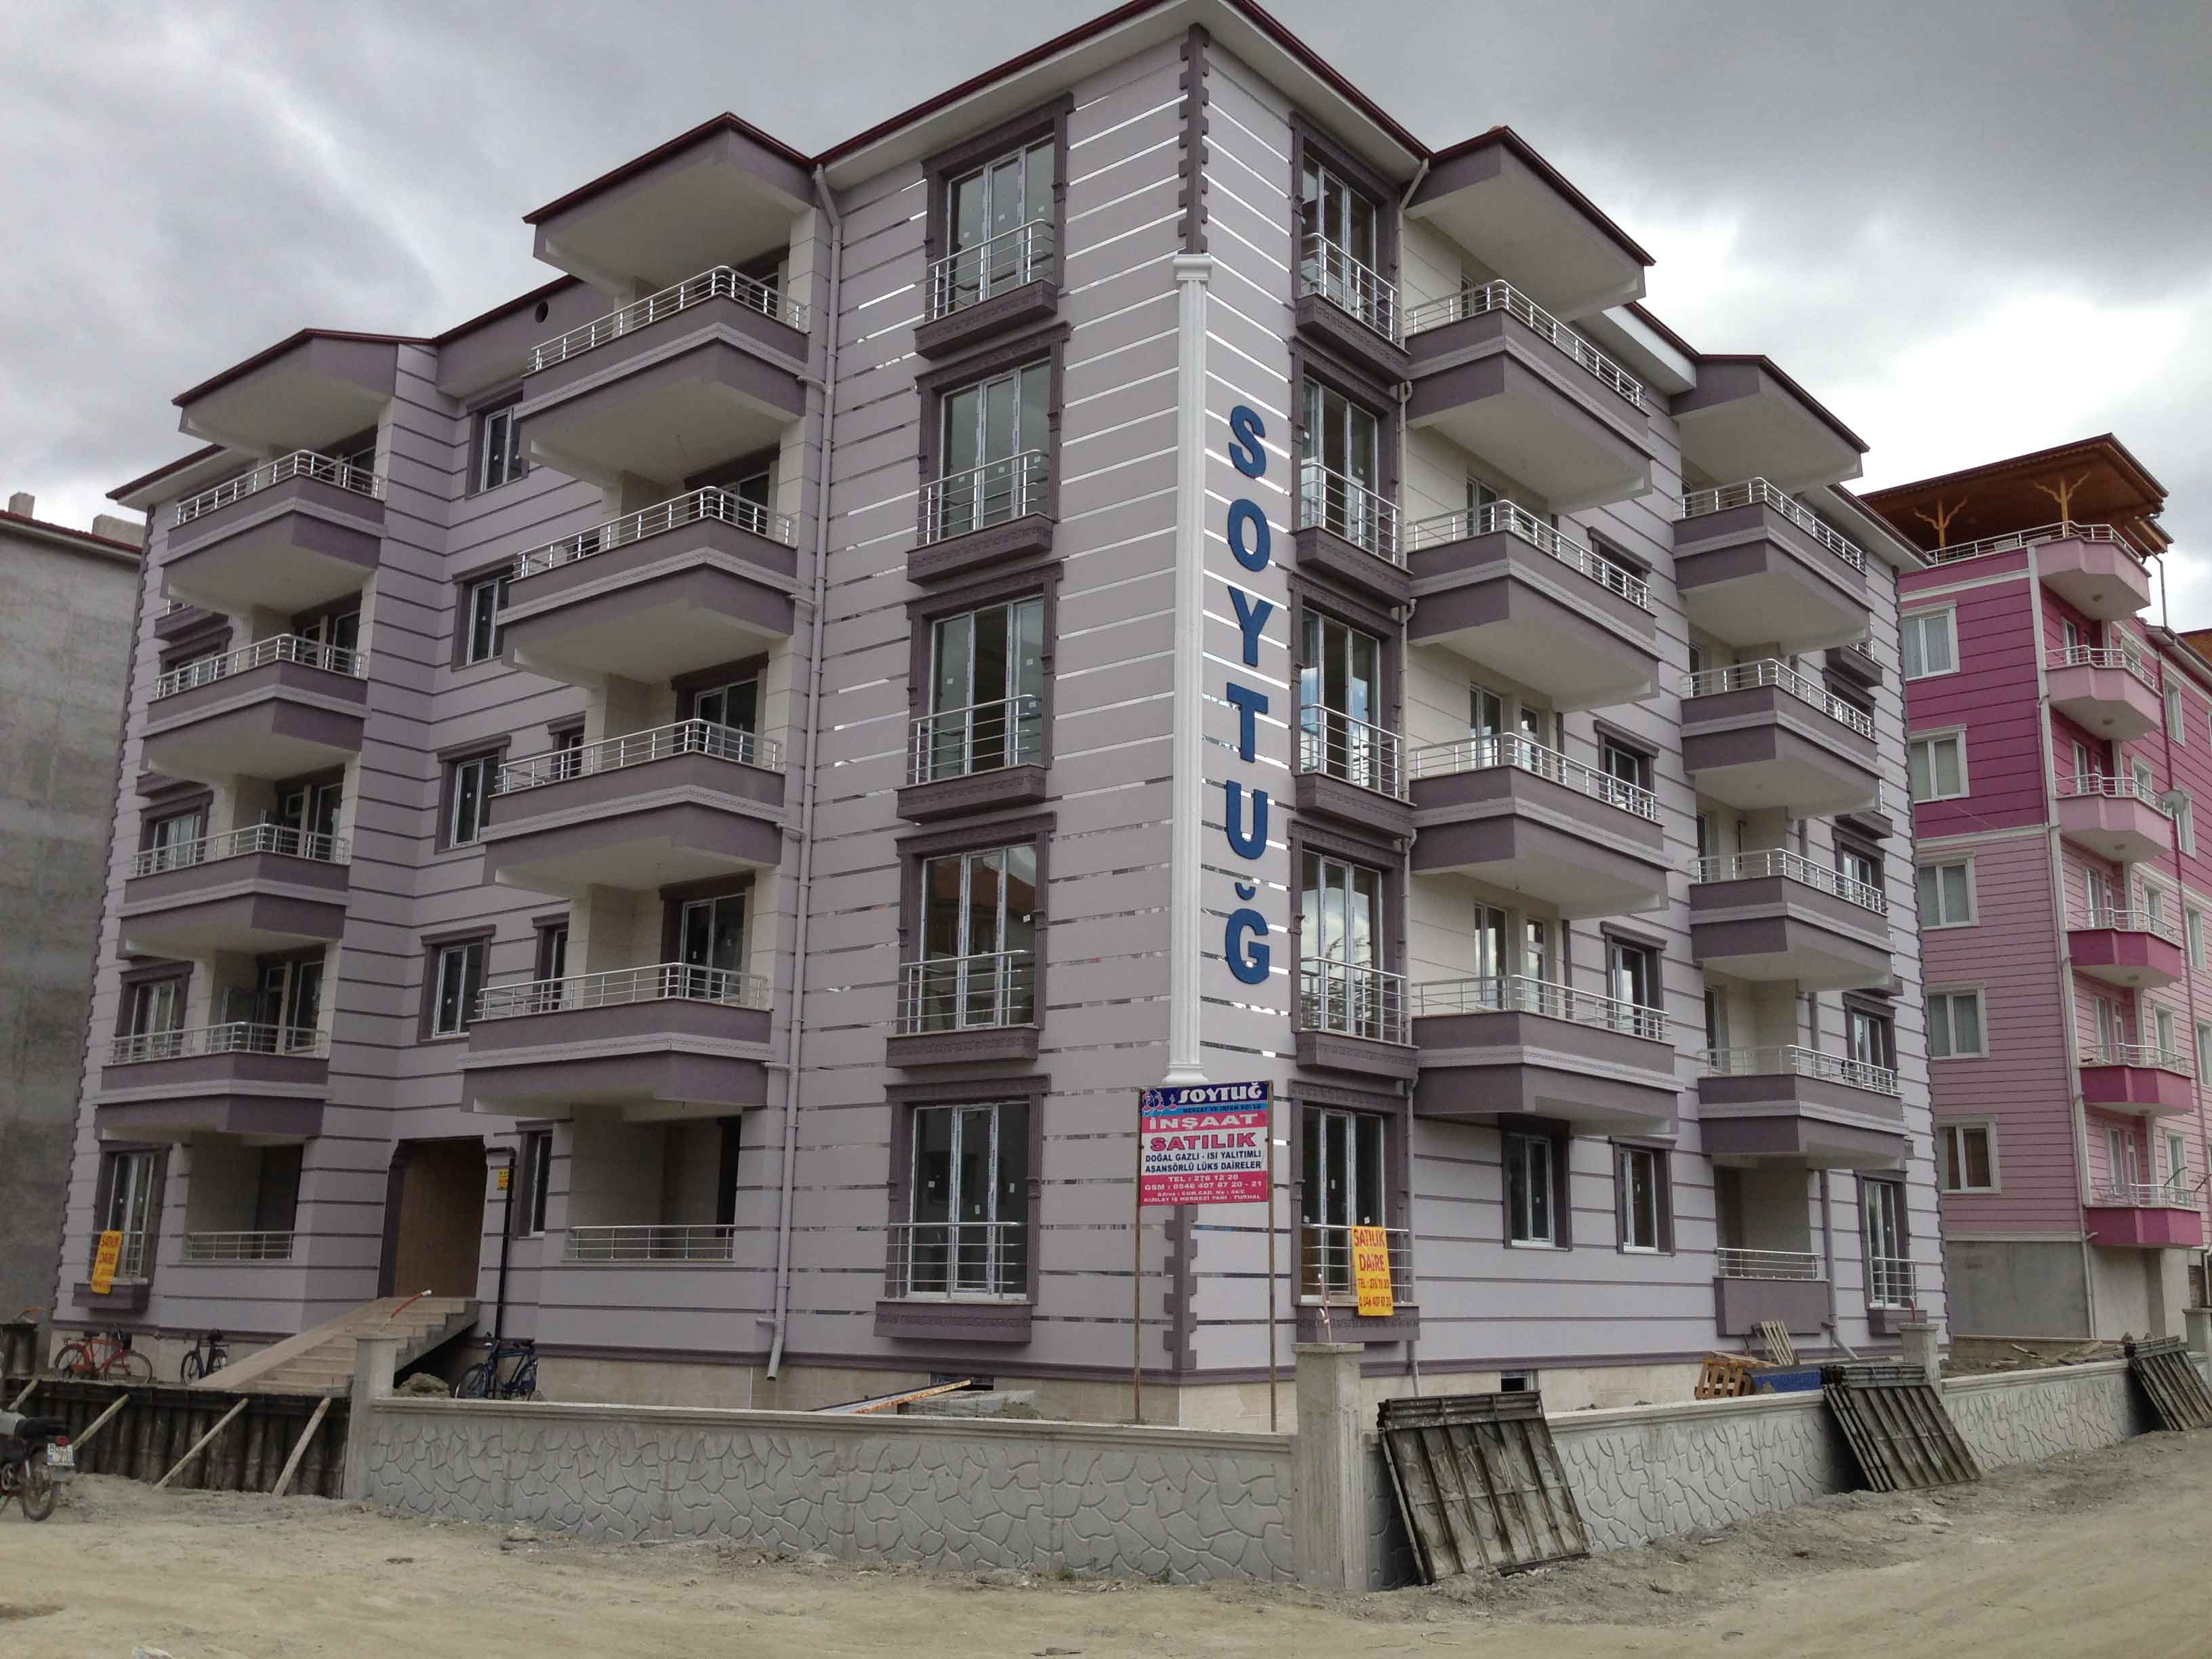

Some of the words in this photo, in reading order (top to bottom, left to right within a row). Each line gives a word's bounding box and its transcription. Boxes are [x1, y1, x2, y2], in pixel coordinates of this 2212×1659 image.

[1225, 405, 1273, 985] SOYTUĞ
[1178, 1083, 1262, 1103] SOYTUĞ
[1149, 1113, 1258, 1130] İNŞAAT
[1150, 1132, 1256, 1151] SATILIK
[1145, 1153, 1172, 1162] DOĞAL
[1175, 1152, 1200, 1161] GAZLI
[1207, 1151, 1218, 1160] ISI
[1221, 1150, 1261, 1159] YALITIMLI
[1145, 1162, 1193, 1172] ASANSÖRLÜ
[1197, 1162, 1218, 1171] LÜKS
[1221, 1160, 1262, 1170] DAİRELER
[1354, 1229, 1385, 1248] SATILIK
[1359, 1253, 1385, 1272] DAİRE
